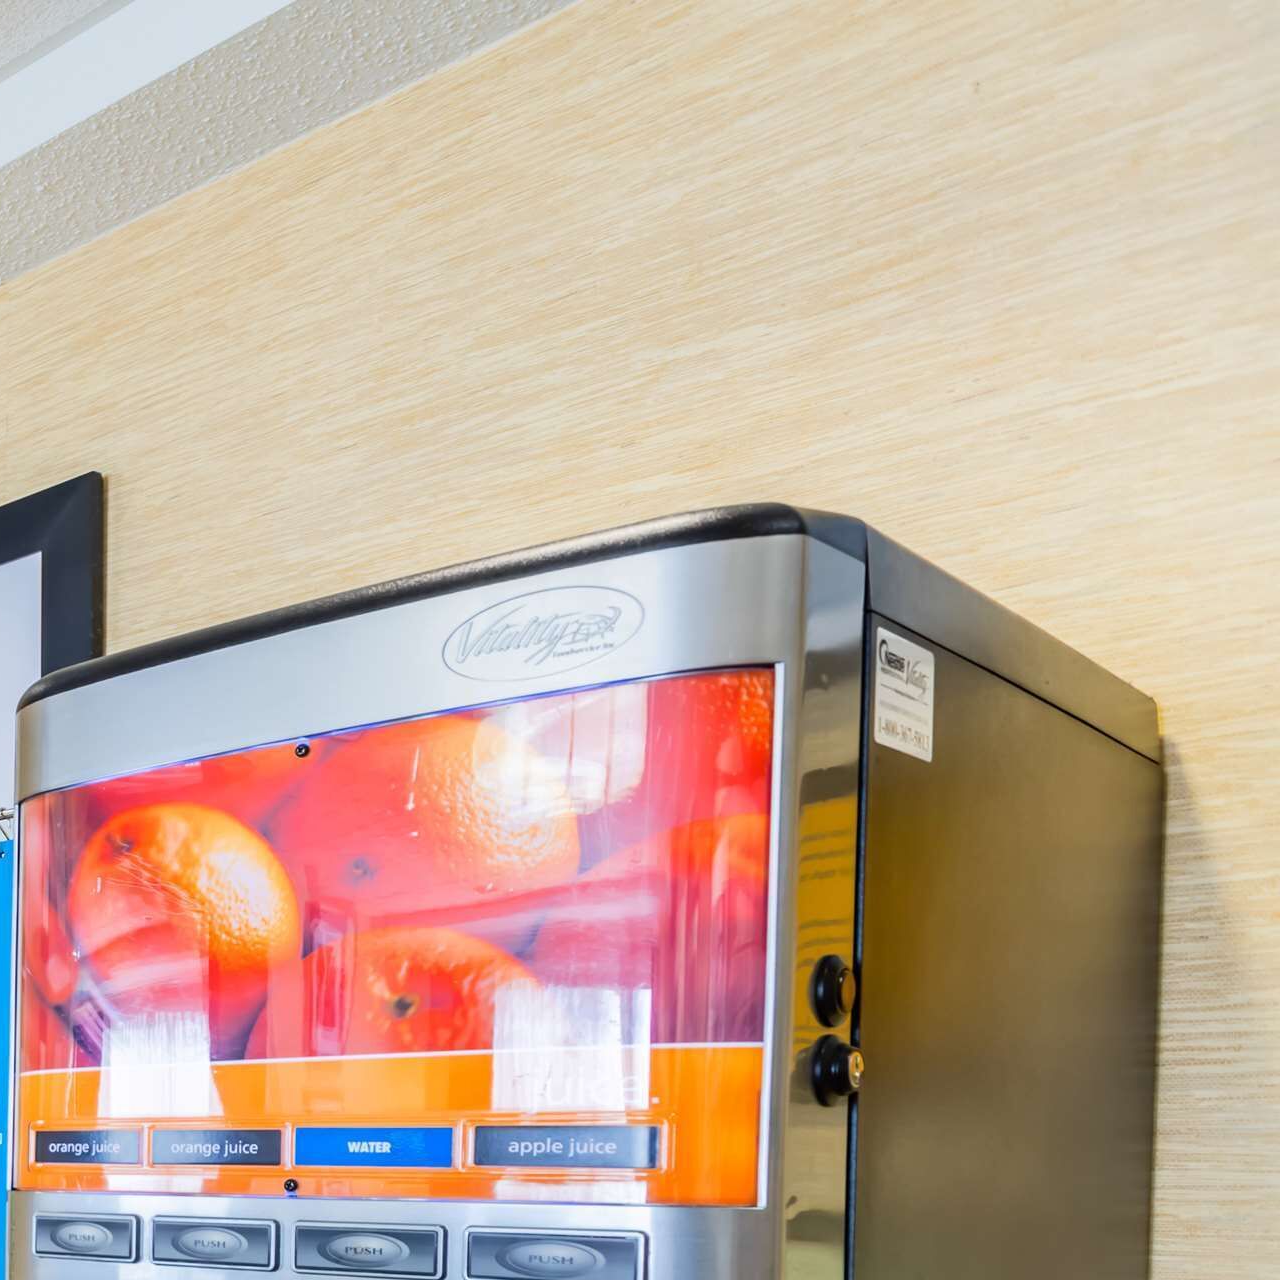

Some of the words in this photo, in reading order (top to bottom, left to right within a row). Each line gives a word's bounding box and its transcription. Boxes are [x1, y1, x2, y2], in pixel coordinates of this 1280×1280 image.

[49, 1141, 90, 1156] orange
[91, 1140, 120, 1155] juice
[170, 1140, 221, 1156] orange
[224, 1139, 259, 1155] juice
[347, 1140, 392, 1154] WATER
[508, 1138, 564, 1156] apple
[568, 1138, 617, 1157] juice
[68, 1232, 96, 1243] PUSH
[193, 1238, 227, 1249] PUSH
[344, 1244, 384, 1256] PUSH
[527, 1254, 575, 1266] PUSH
